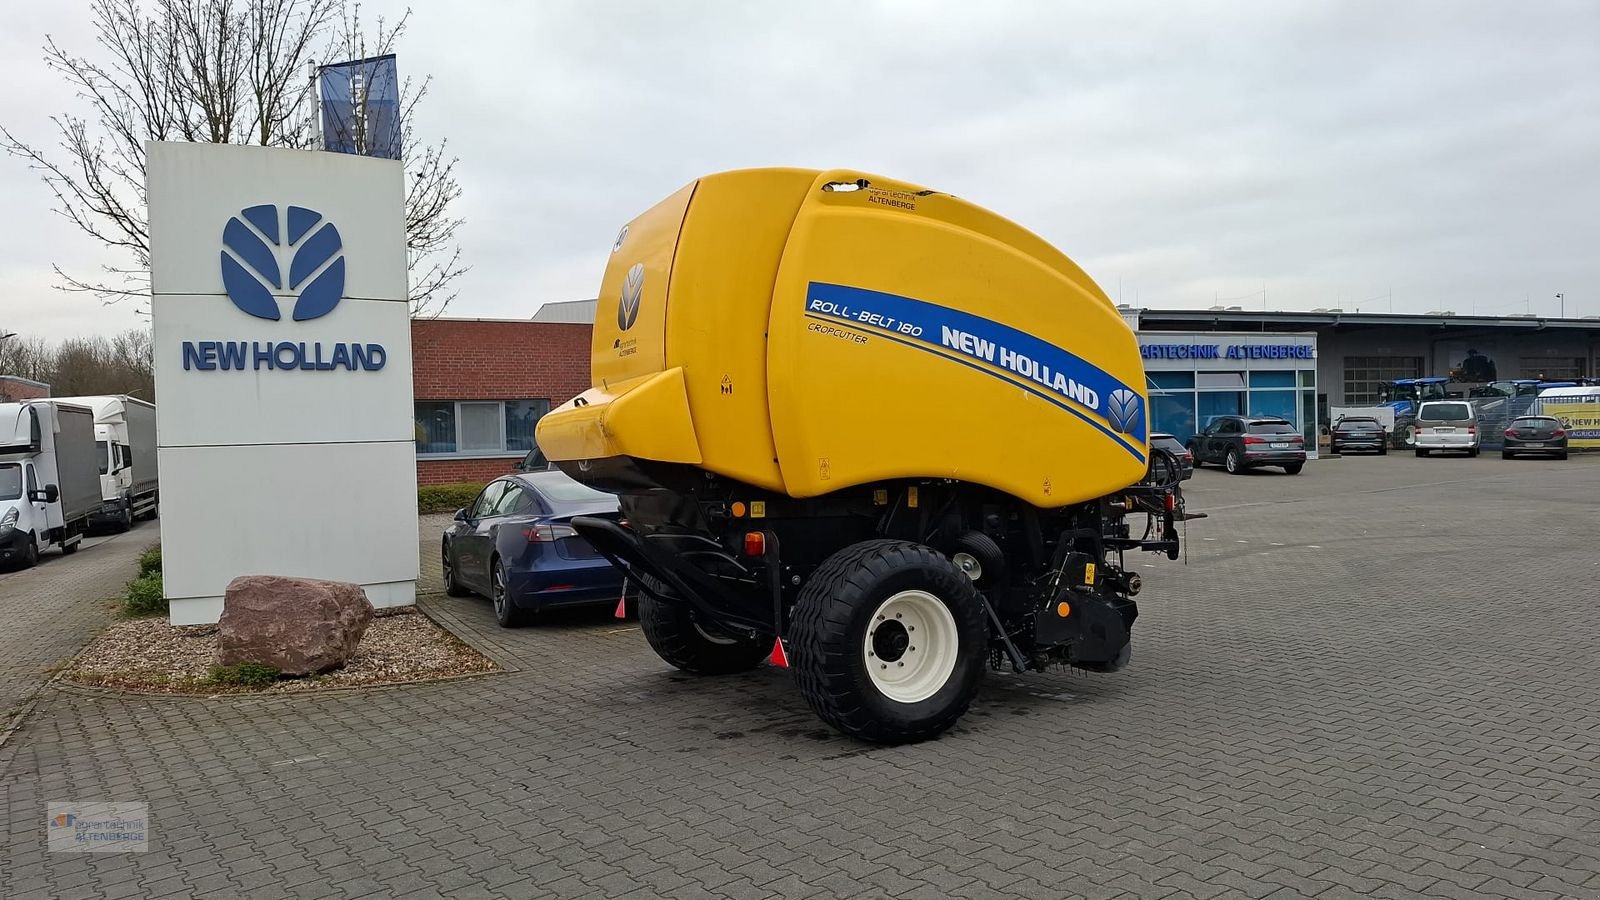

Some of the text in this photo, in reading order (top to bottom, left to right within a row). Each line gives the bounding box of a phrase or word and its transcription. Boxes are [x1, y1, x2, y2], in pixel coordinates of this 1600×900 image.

[868, 195, 916, 210] ALTENBERGE
[807, 322, 868, 344] CROPCUTTER
[897, 321, 923, 336] 180
[182, 341, 387, 371] NEW HOLLAND
[1226, 345, 1313, 359] ALTENBERGE
[942, 325, 1099, 410] NEW HOLLAND
[1572, 418, 1592, 426] NEW
